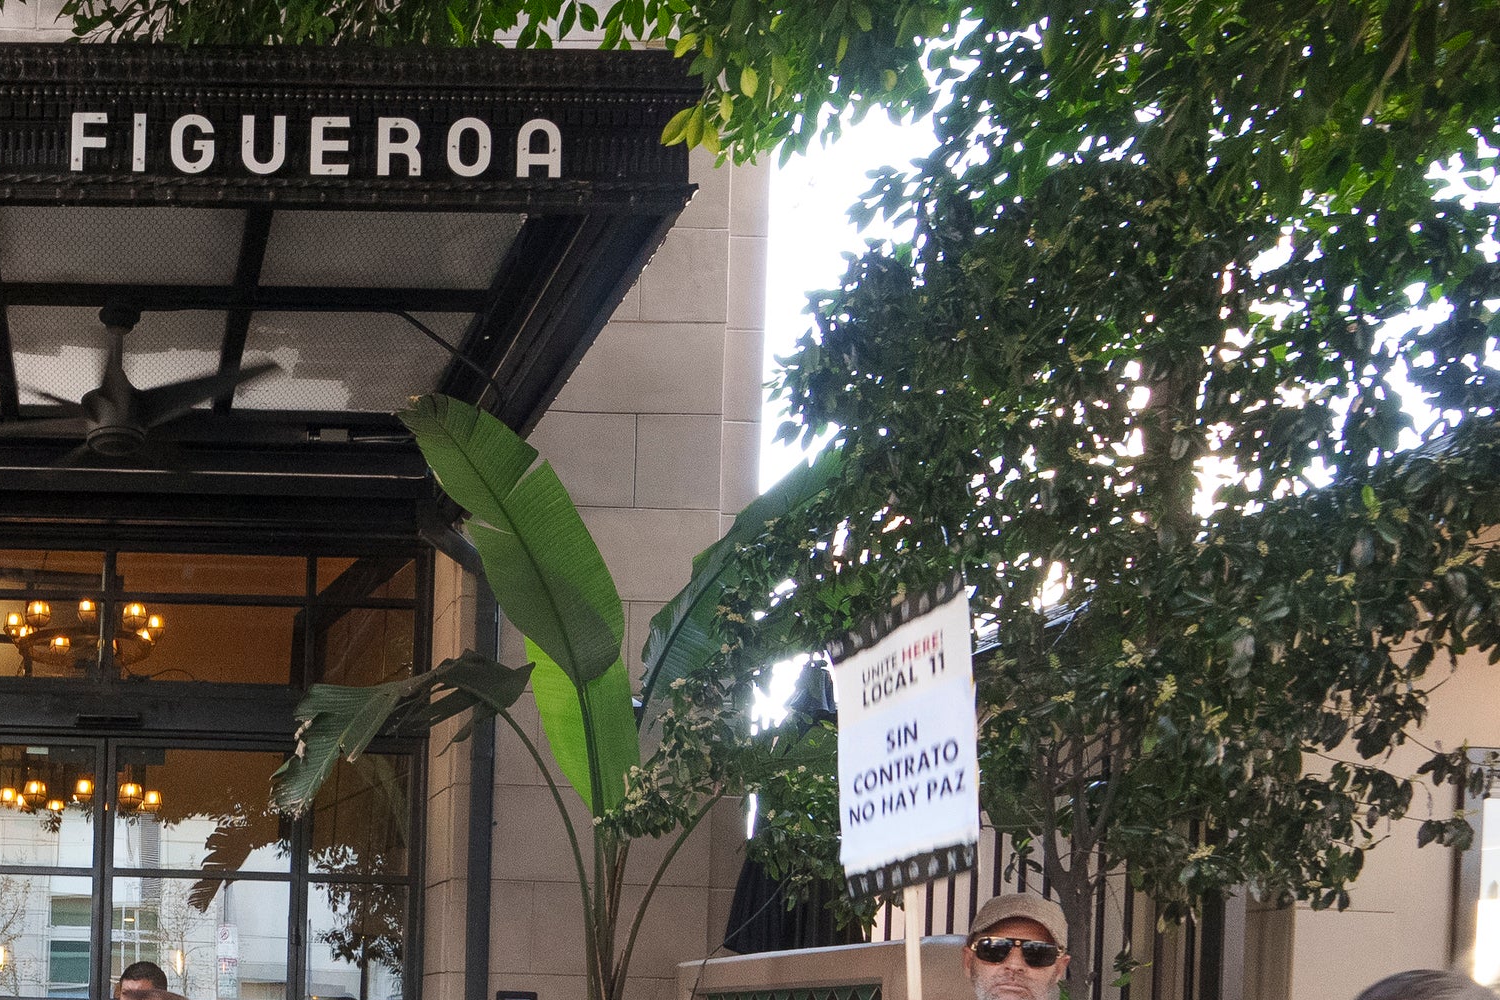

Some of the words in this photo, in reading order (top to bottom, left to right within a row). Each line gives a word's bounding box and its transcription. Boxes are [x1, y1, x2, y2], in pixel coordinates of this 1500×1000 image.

[70, 111, 562, 179] FIGUEROA
[861, 651, 898, 686] UNITE
[861, 663, 919, 708] LOCAL
[929, 650, 946, 676] 11
[885, 719, 919, 753] SIN
[853, 737, 960, 797] CONTRATO
[848, 799, 876, 828] NO
[881, 783, 920, 818] HAY
[926, 767, 967, 804] PAZ
